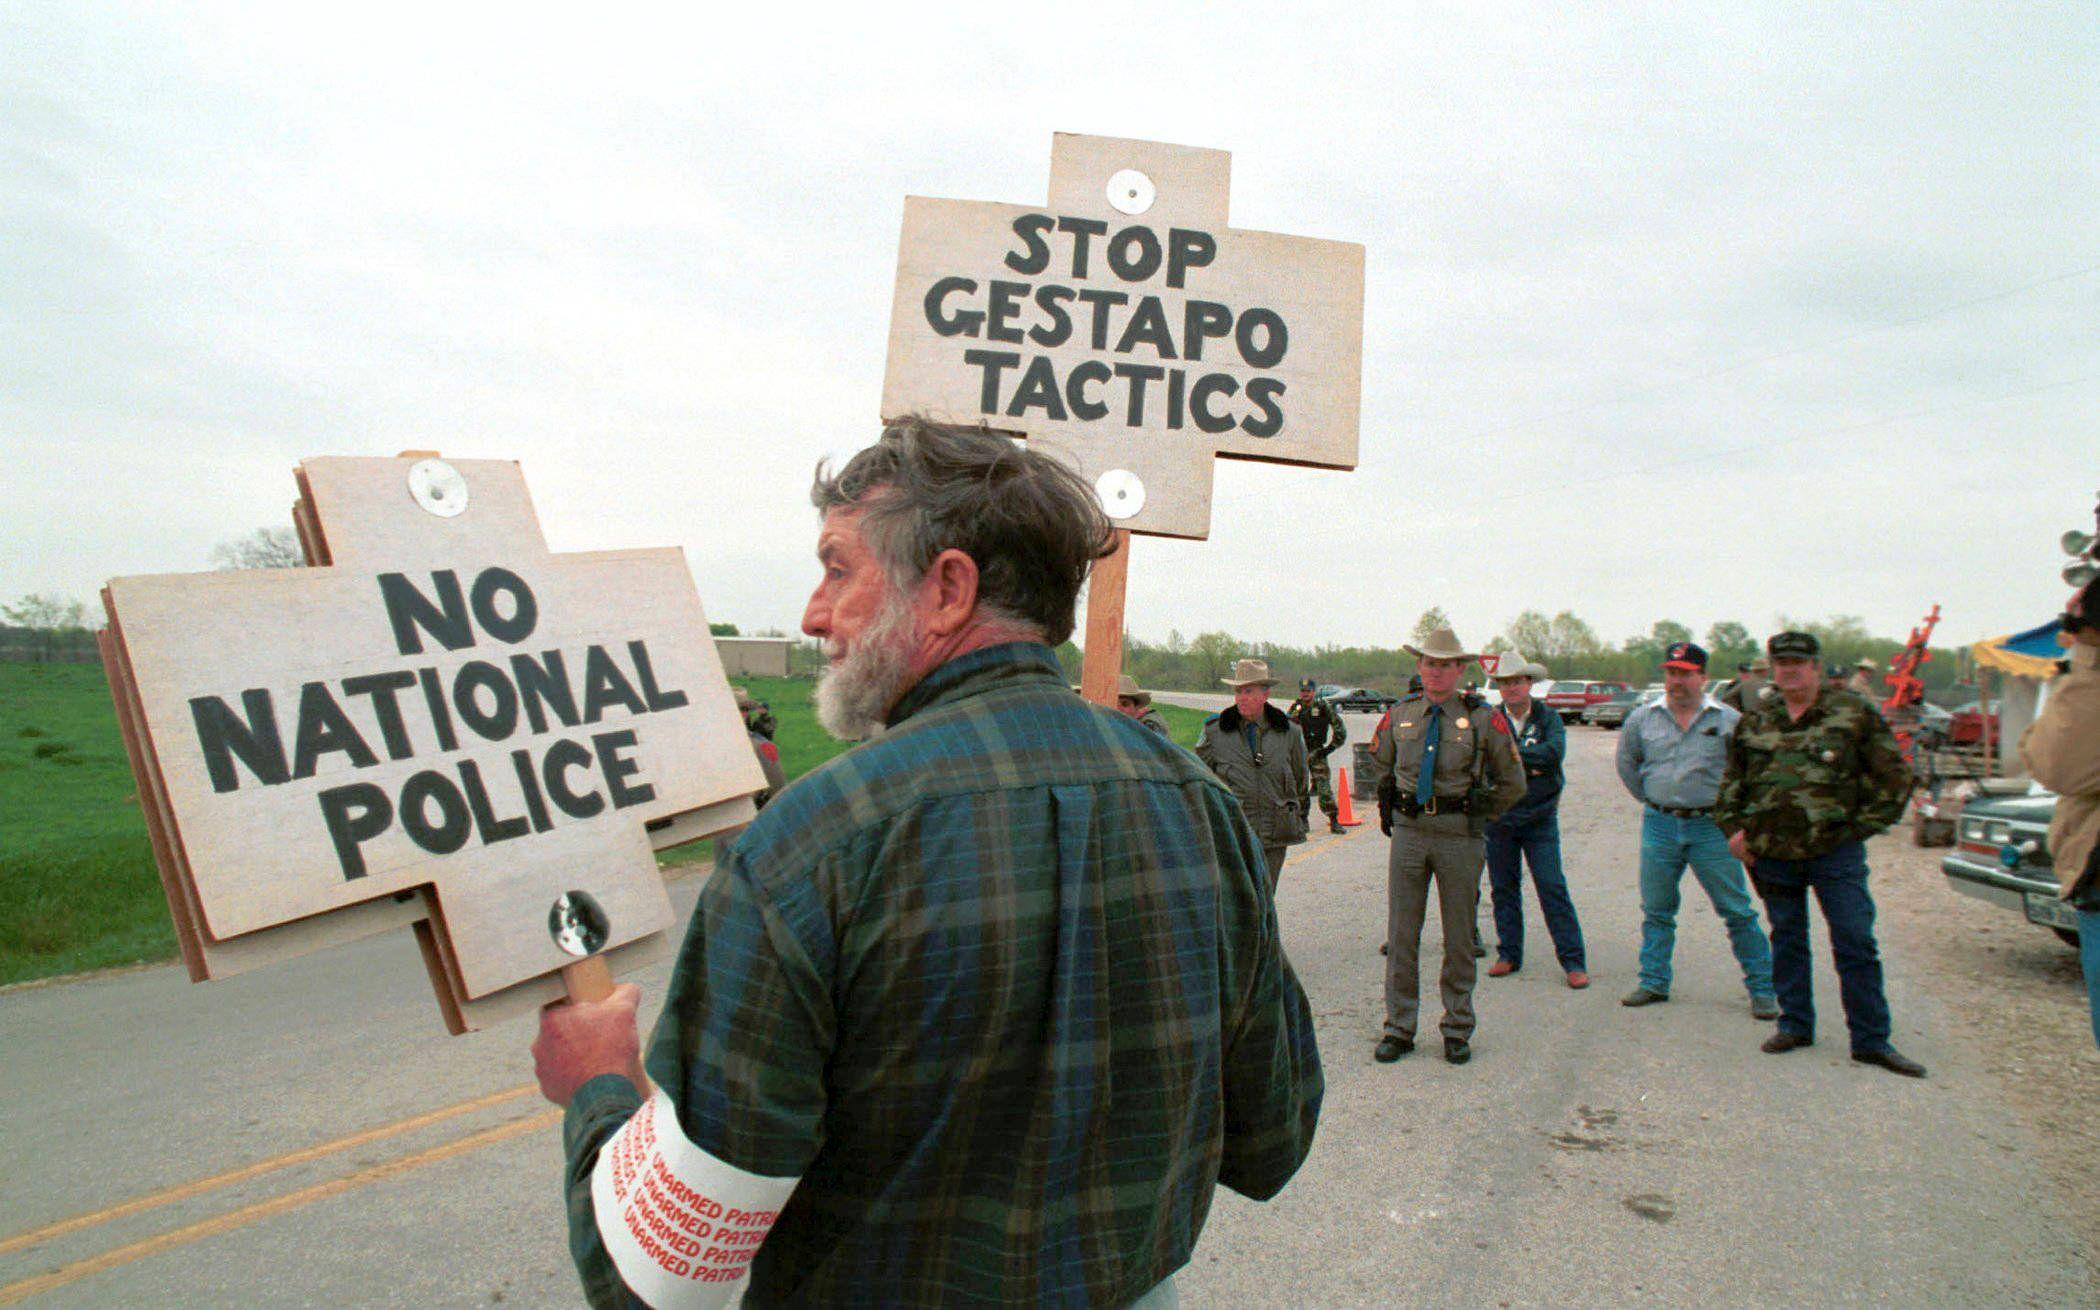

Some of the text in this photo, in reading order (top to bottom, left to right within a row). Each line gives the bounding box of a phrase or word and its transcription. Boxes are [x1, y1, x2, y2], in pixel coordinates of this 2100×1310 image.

[1004, 213, 1217, 289] STOP
[924, 276, 1289, 370] GESTAPO
[964, 349, 1287, 439] TACTICS
[377, 566, 538, 656] NO
[188, 640, 690, 794] NATIONAL
[317, 729, 657, 882] POLICE
[634, 1187, 701, 1257] UNARMED
[643, 1169, 712, 1238] UNARMED
[653, 1152, 723, 1219] UNARMED
[624, 1204, 690, 1276] UNARMED
